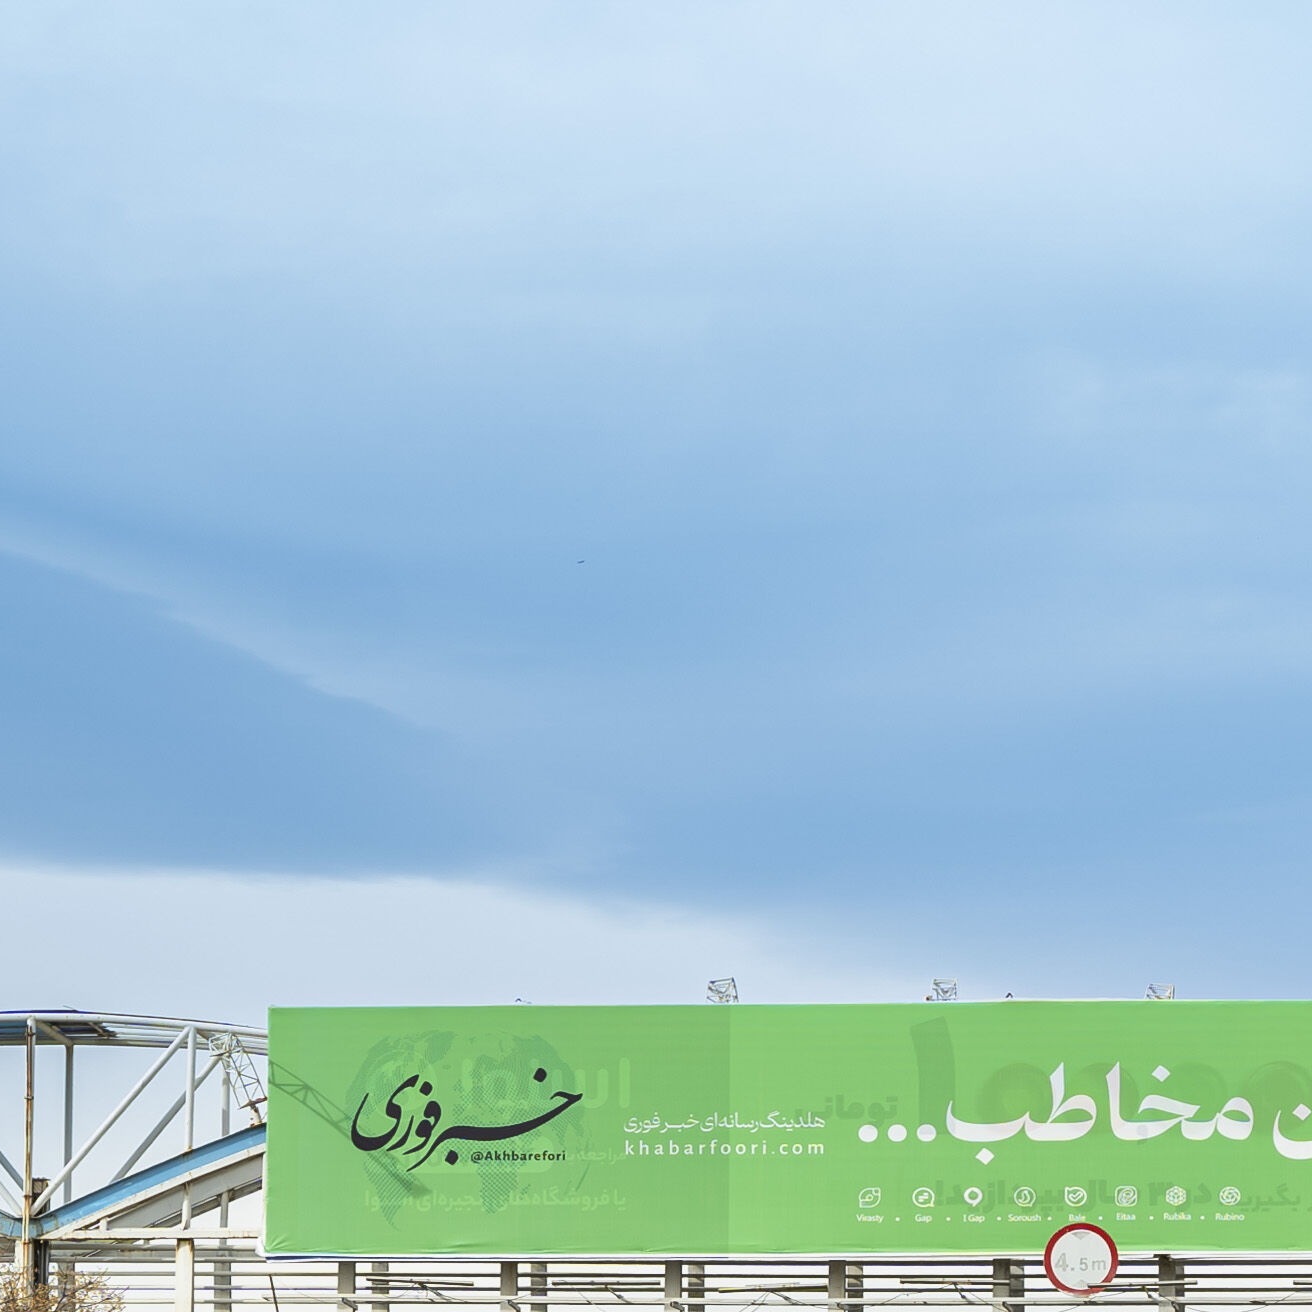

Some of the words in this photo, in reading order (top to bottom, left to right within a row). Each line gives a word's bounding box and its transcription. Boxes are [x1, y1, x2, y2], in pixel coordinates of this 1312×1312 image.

[624, 1111, 660, 1133] فوری
[660, 1114, 699, 1133] خبر
[760, 1111, 826, 1131] هلدینگ
[625, 1140, 825, 1155] khabarfoori.com
[470, 1151, 567, 1162] @Akhbarefori
[914, 1214, 932, 1223] Gap
[1008, 1214, 1041, 1222] Soroush
[1163, 1212, 1192, 1221] Rubika
[1215, 1212, 1245, 1221] Rubino
